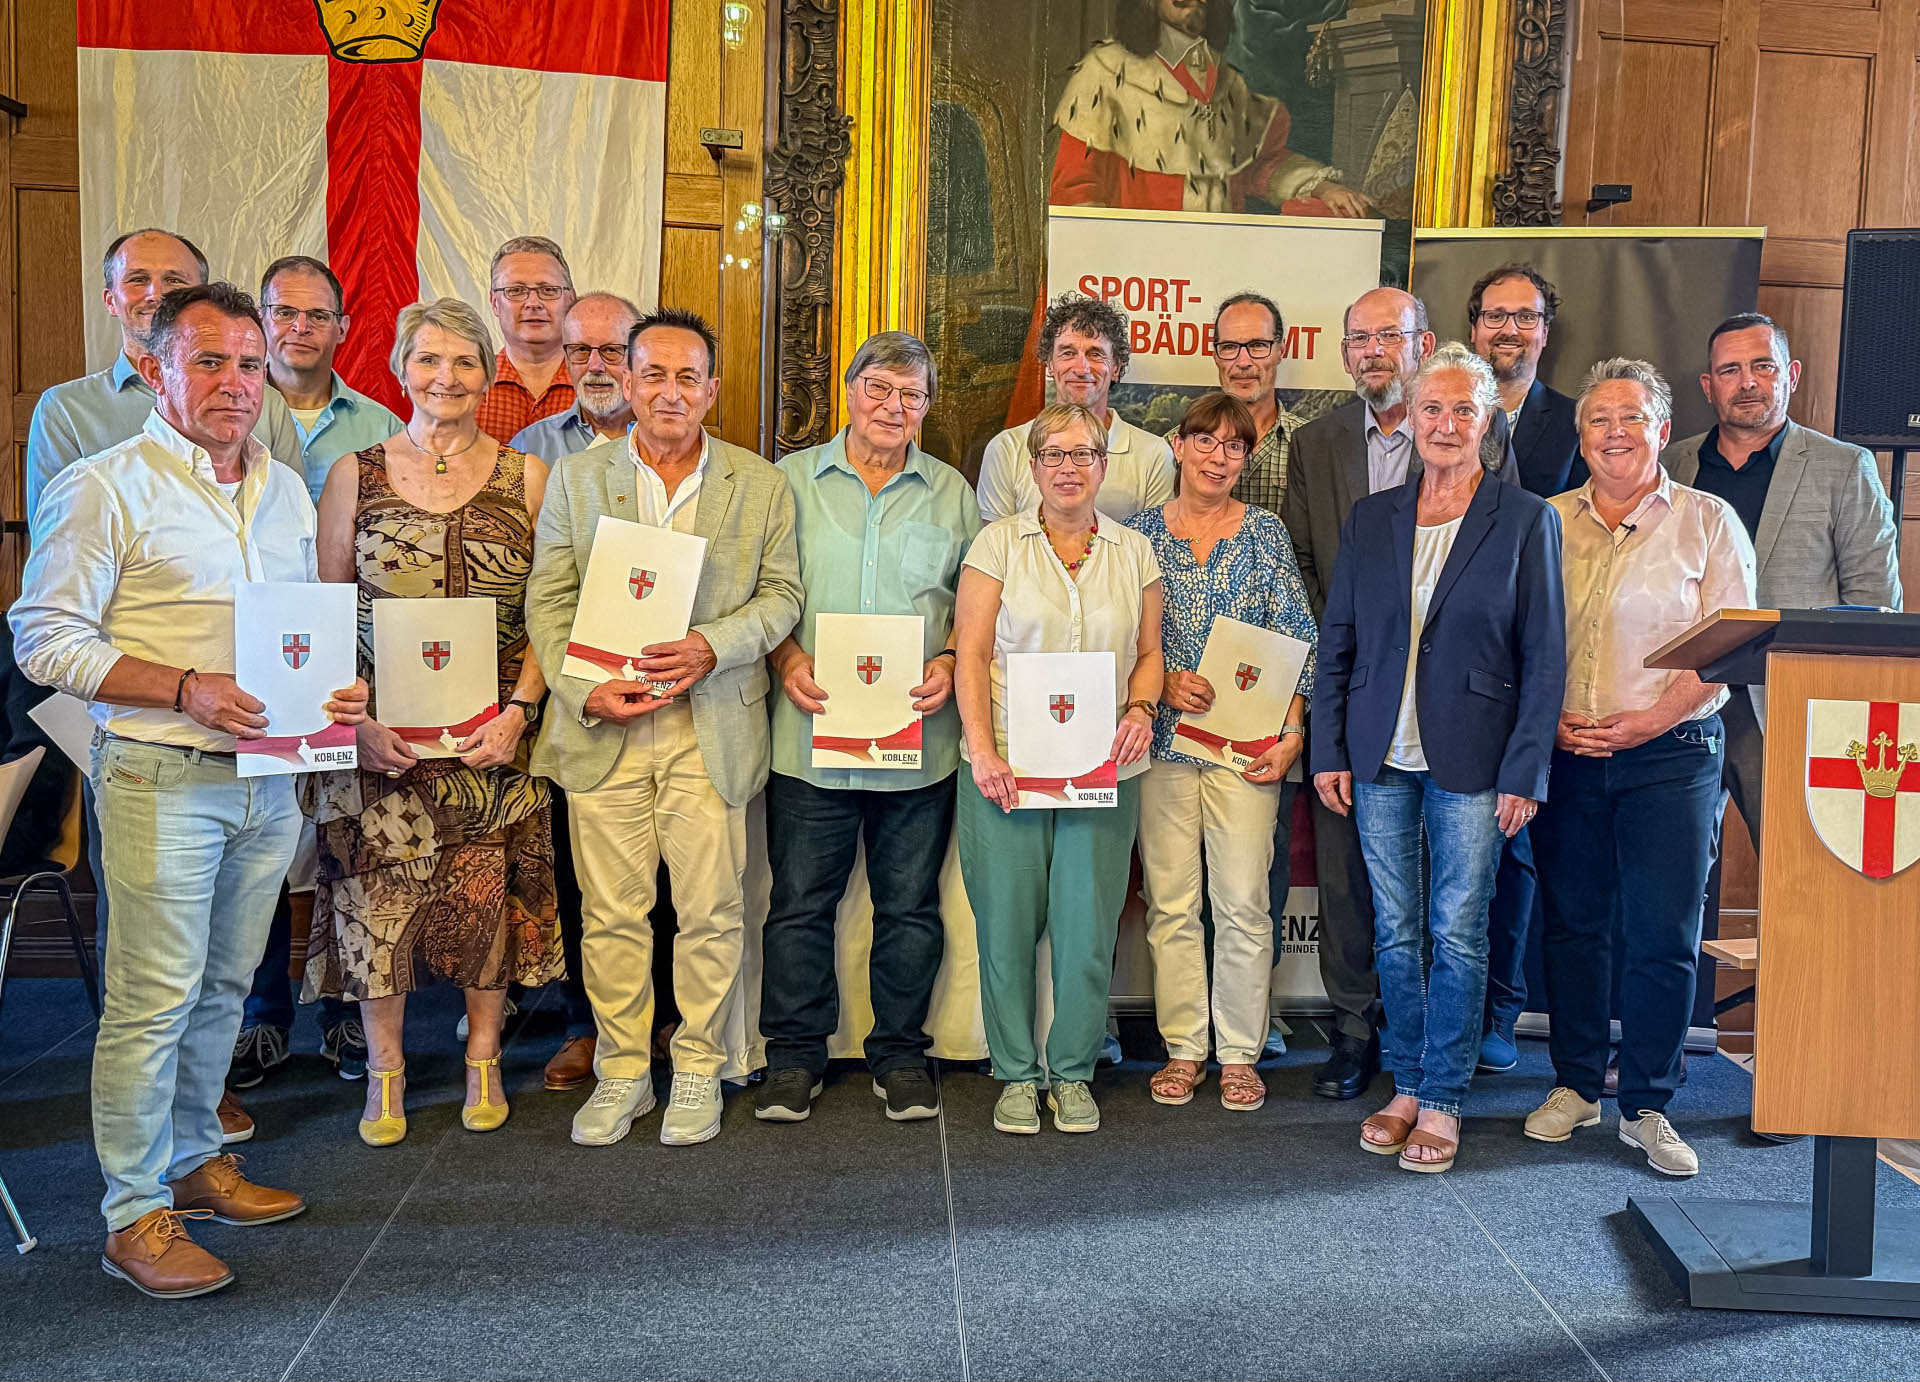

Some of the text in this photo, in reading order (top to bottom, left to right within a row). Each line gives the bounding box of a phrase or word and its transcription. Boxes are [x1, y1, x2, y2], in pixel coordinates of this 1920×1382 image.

[1079, 275, 1201, 312] SPORT-
[314, 751, 354, 763] KOBLENZ
[882, 753, 918, 762] KOBLENZ
[1078, 792, 1114, 801] KOBLENZ
